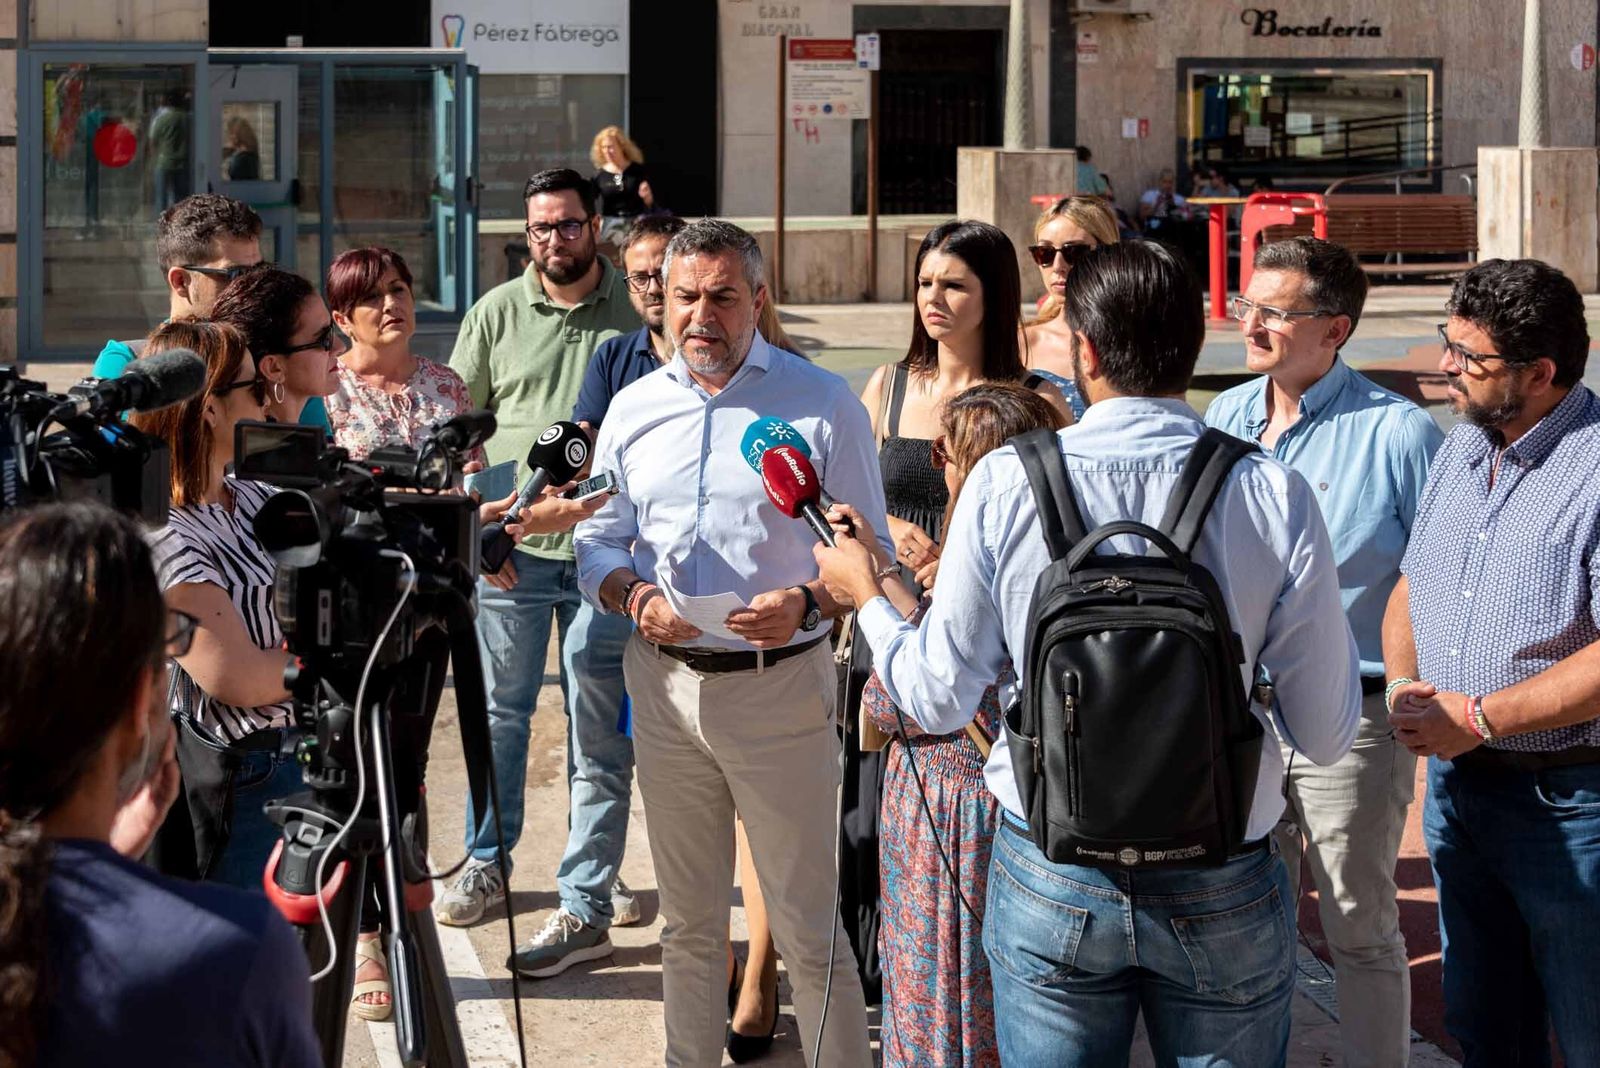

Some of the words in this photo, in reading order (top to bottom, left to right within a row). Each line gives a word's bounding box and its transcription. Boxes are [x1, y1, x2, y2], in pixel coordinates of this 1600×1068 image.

[473, 23, 529, 42] Pérez
[534, 23, 620, 47] Fábrega
[1240, 8, 1382, 37] Bocatería
[781, 451, 807, 486] esRadio
